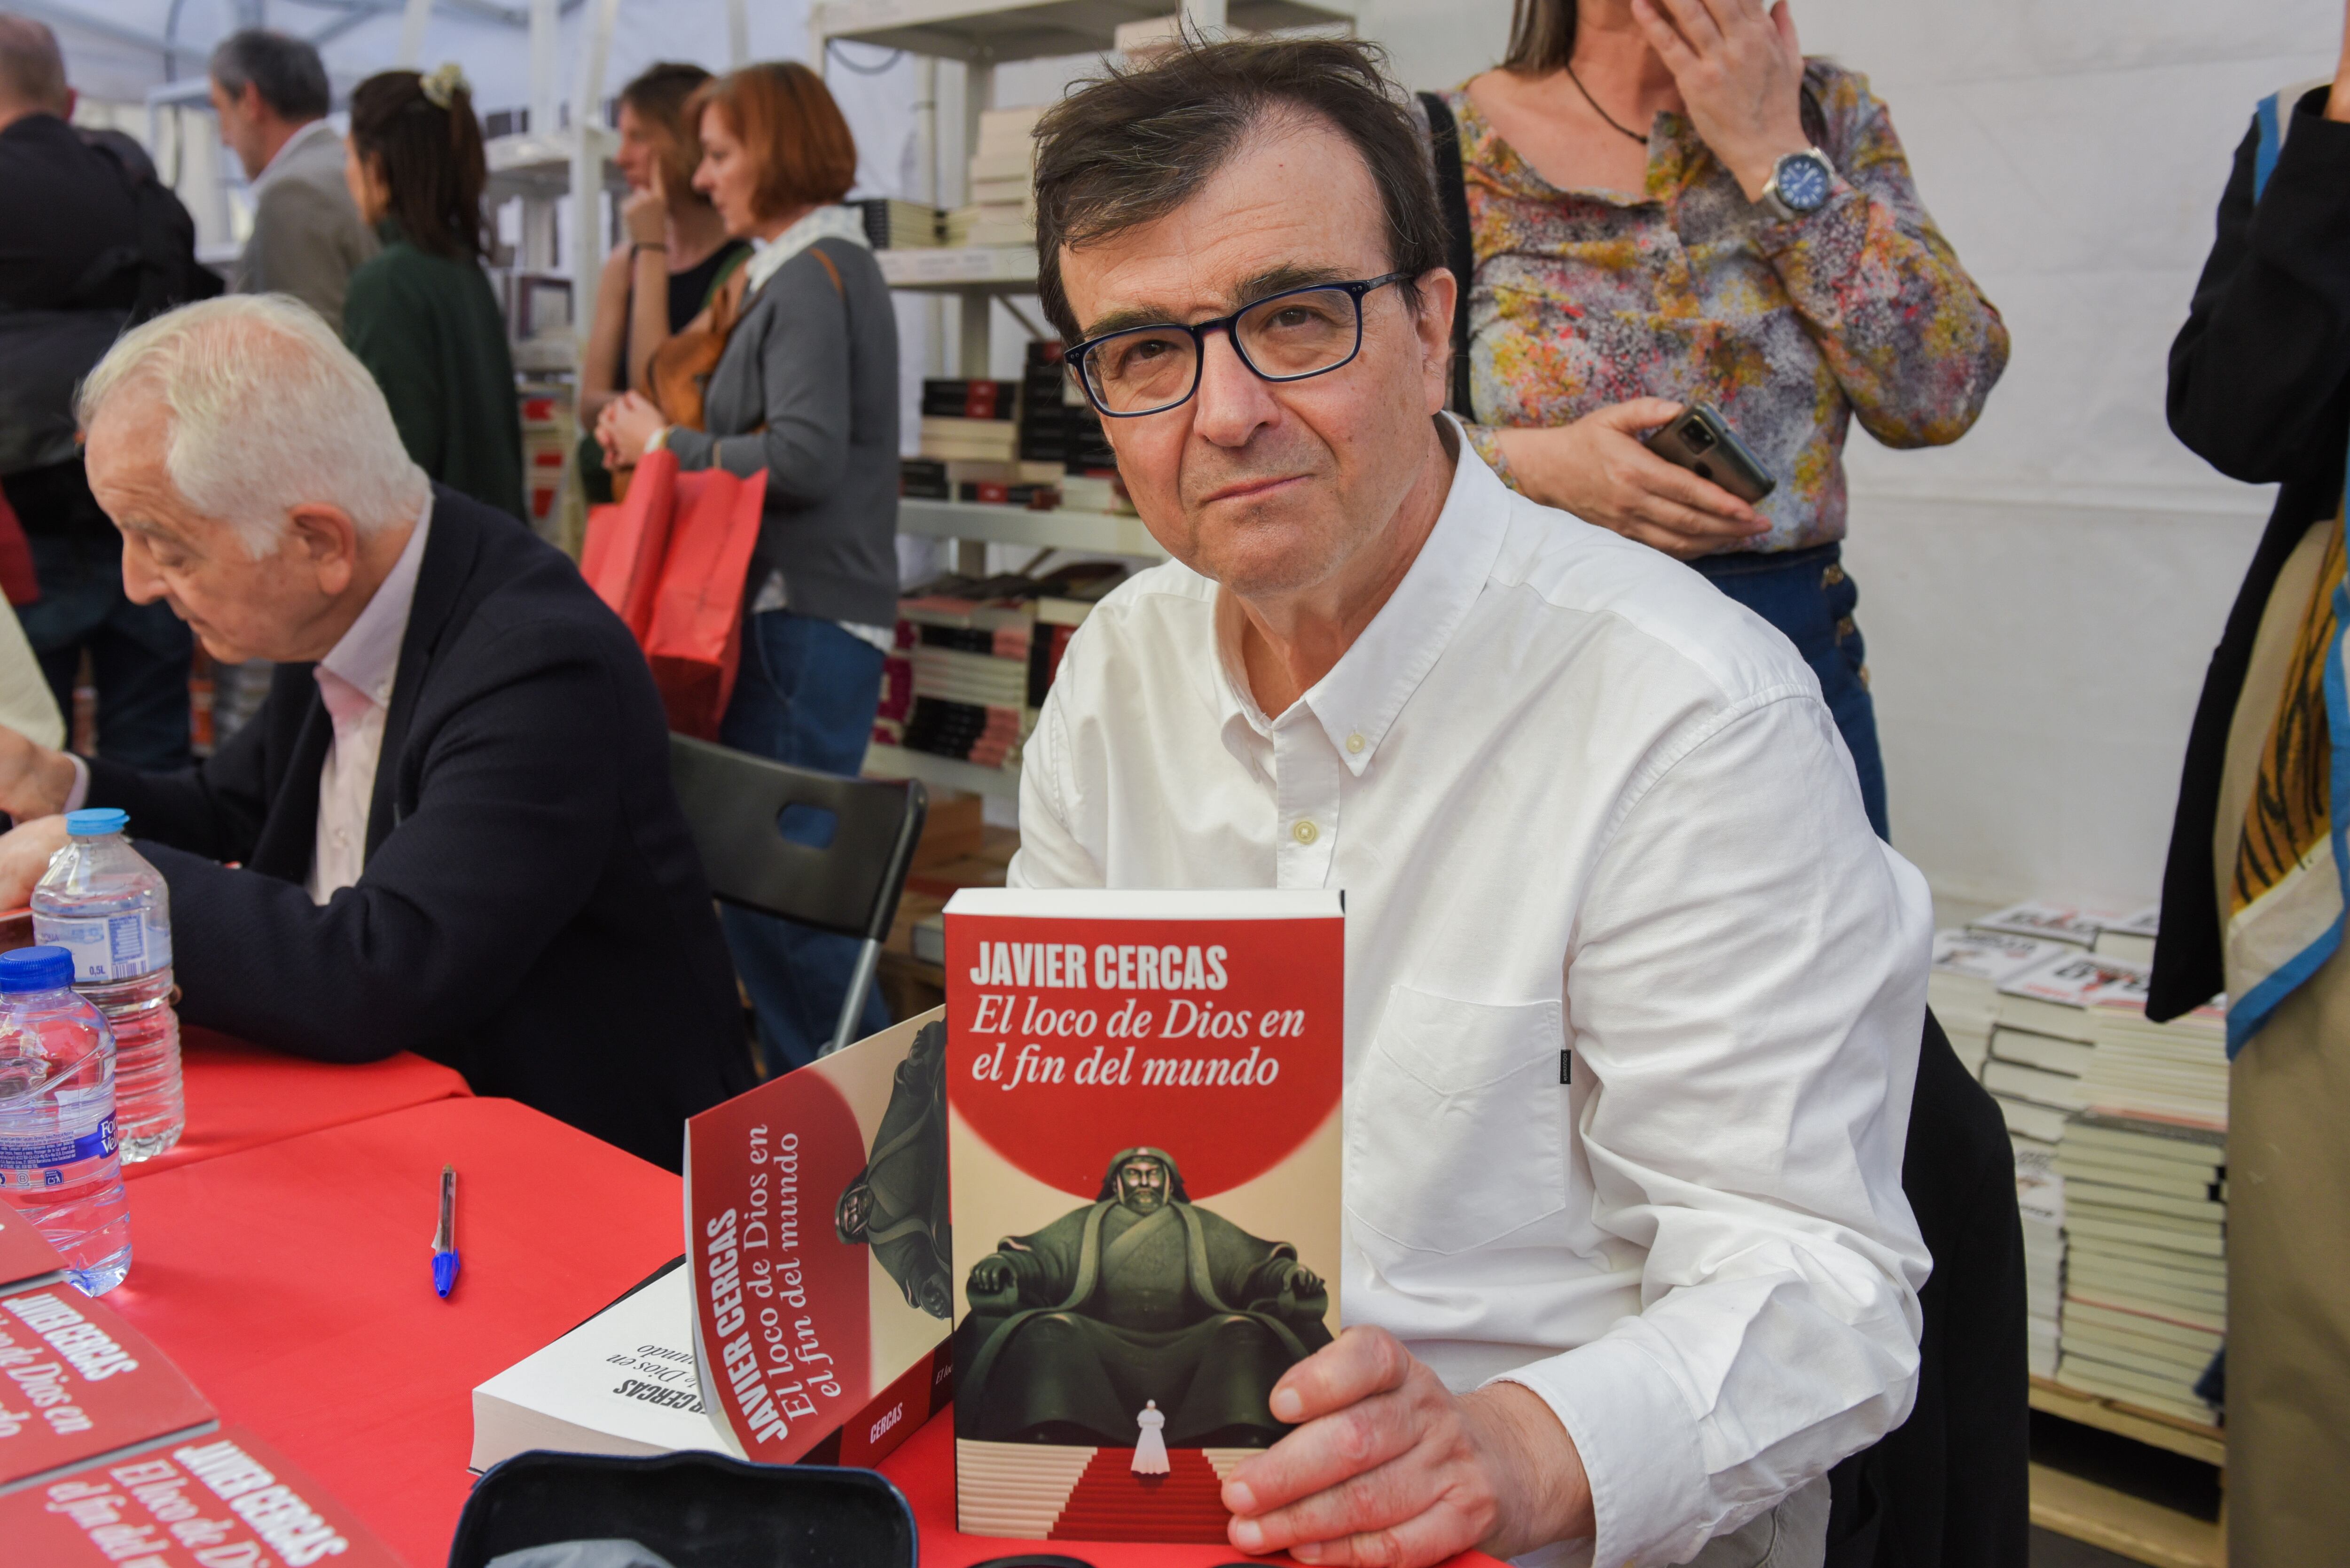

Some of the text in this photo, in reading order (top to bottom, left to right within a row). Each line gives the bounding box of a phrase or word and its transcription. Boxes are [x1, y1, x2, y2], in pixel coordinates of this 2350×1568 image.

[89, 965, 106, 976] 0,5L
[969, 941, 1229, 991] JAVIER CERCAS
[968, 994, 1305, 1039] El loco de Dios en
[971, 1042, 1280, 1092] el fin del mundo
[743, 1123, 818, 1422] El loco de Dios en
[773, 1132, 841, 1397] el fin del mundo
[1, 1293, 85, 1334] JAVIER
[43, 1322, 139, 1381] CERCAS
[706, 1208, 788, 1444] JAVIER CERCAS
[606, 1354, 637, 1366] en
[633, 1361, 690, 1383] Dios
[636, 1345, 694, 1365] undo
[6, 1361, 73, 1408] Dios
[43, 1405, 94, 1435] en
[612, 1379, 697, 1409] CERCAS
[870, 1402, 903, 1444] CERCAS
[935, 1368, 944, 1385] El
[172, 1440, 349, 1567] JAVIER CERCAS
[89, 1523, 170, 1561] del
[169, 1518, 235, 1548] de
